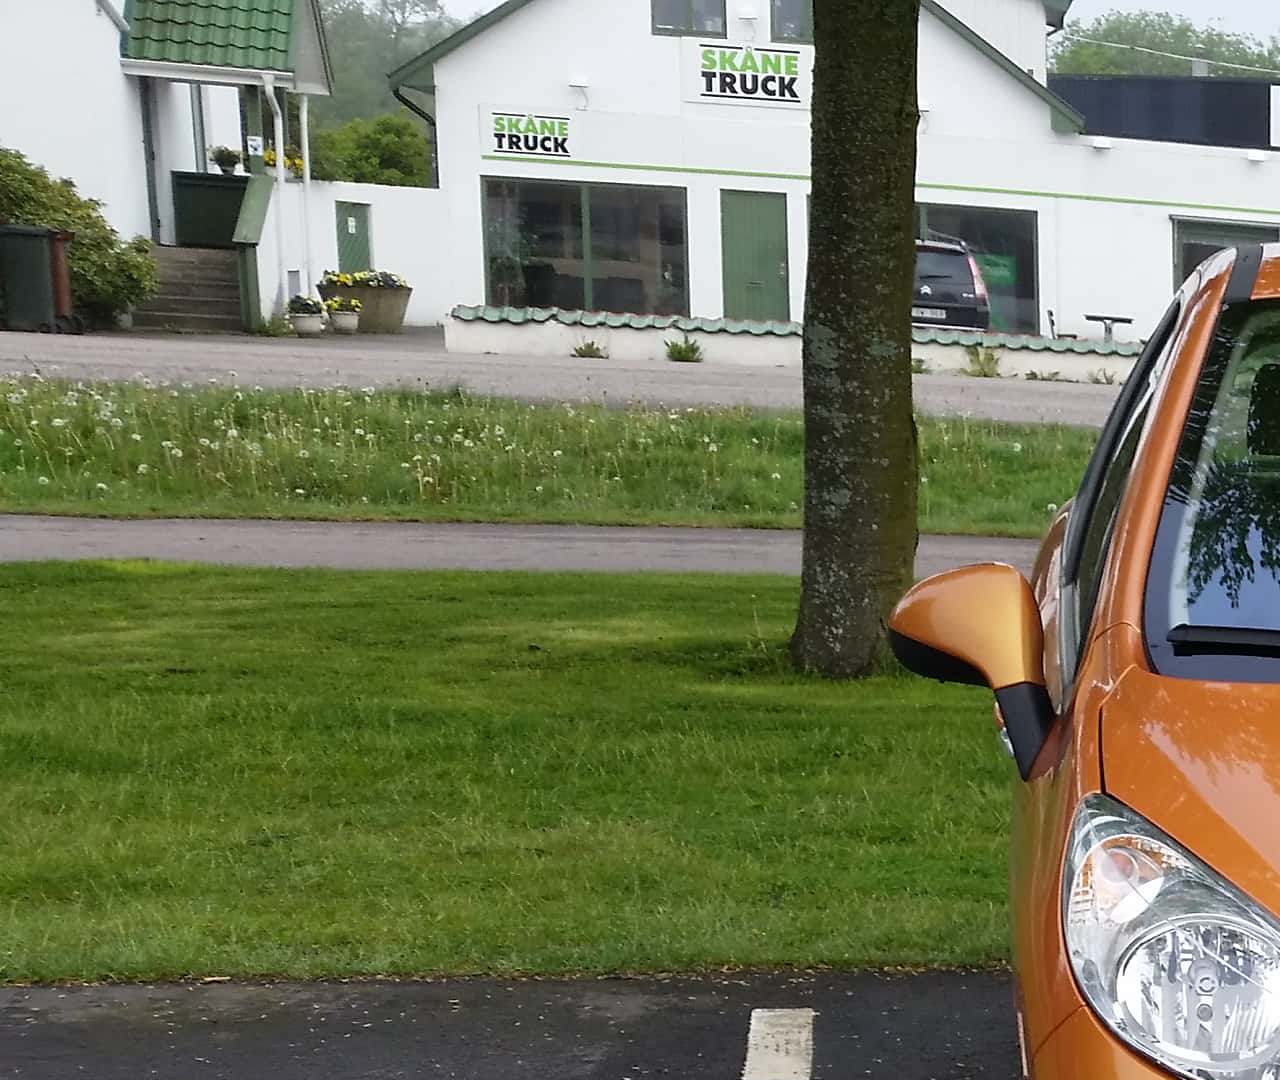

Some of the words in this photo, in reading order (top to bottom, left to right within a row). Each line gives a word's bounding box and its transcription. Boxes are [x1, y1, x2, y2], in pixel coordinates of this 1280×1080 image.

[700, 45, 799, 76] SKÅNE
[701, 71, 799, 98] TRUCK
[494, 114, 569, 137] SKÅNE
[493, 132, 570, 153] TRUCK
